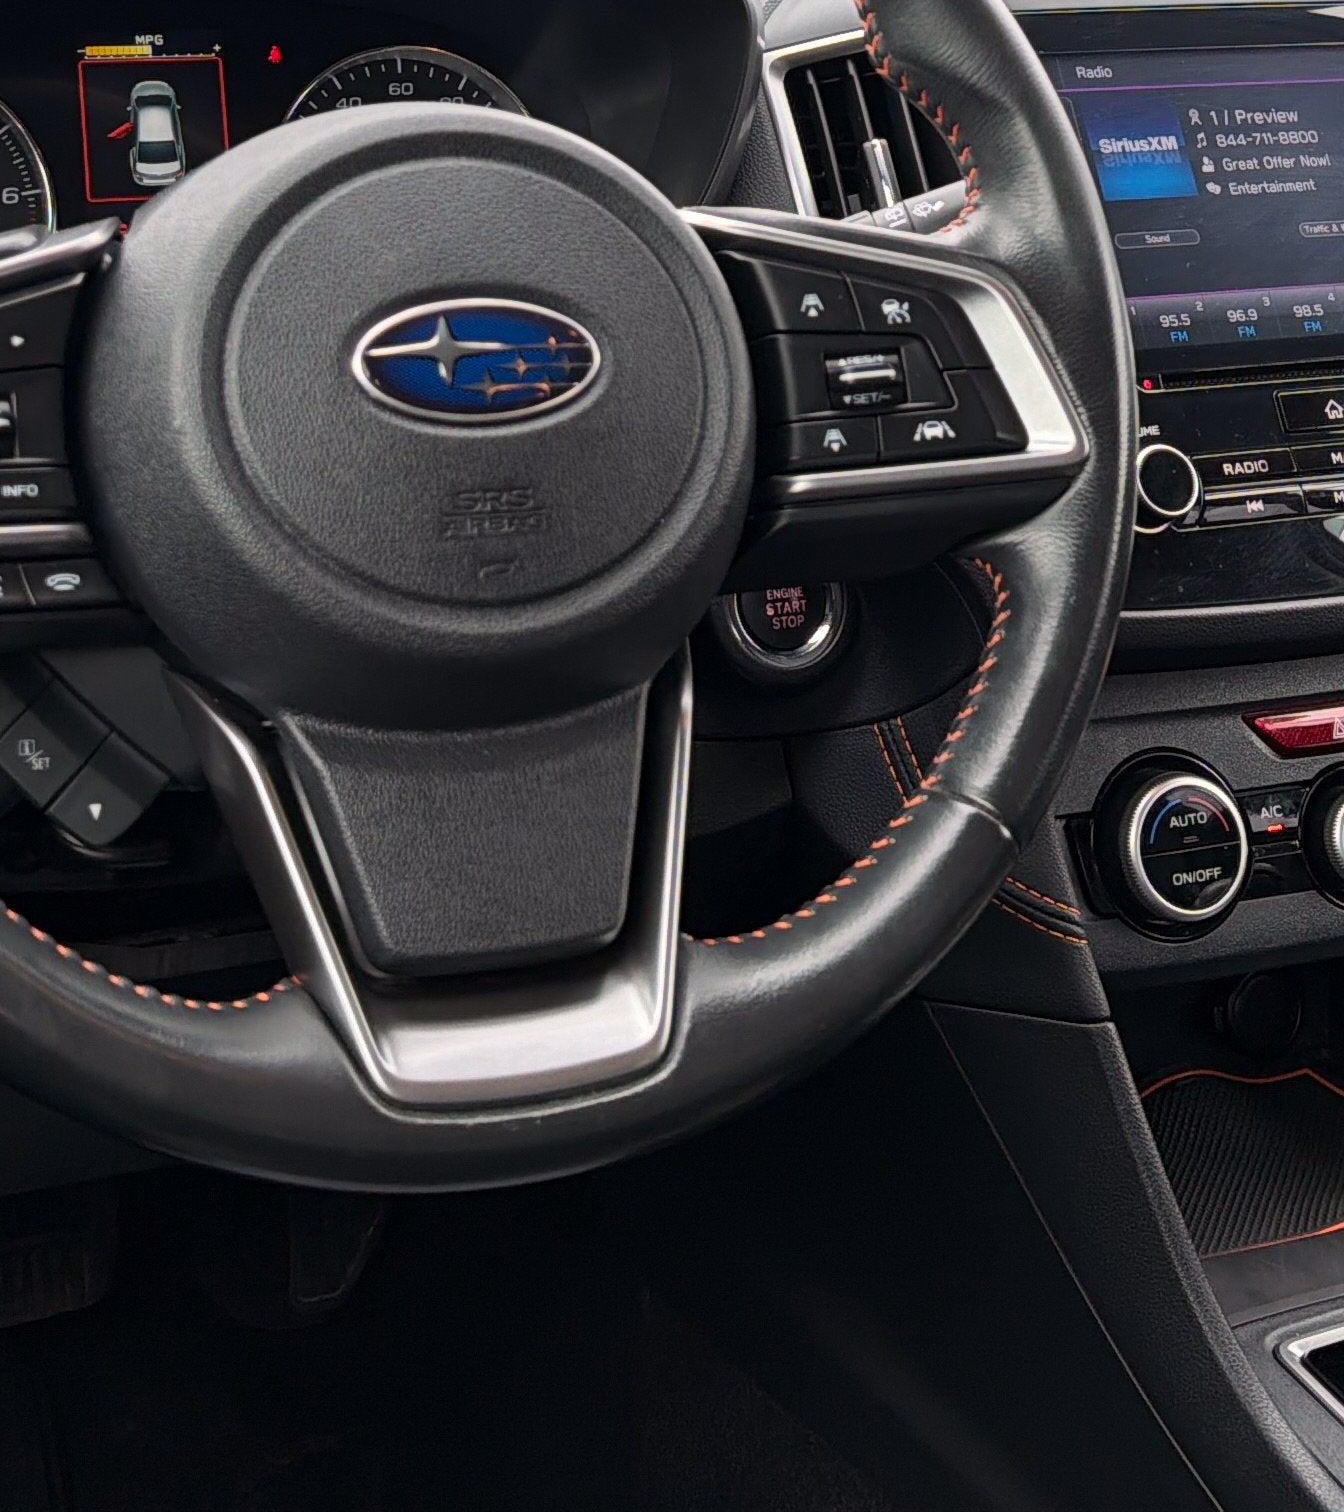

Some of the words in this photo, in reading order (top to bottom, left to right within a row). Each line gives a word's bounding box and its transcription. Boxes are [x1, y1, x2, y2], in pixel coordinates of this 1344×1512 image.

[135, 34, 164, 46] MPG
[1076, 65, 1113, 80] Radio
[388, 82, 414, 96] 60
[1209, 109, 1217, 125] 1
[1235, 107, 1299, 125] Preview
[1098, 135, 1179, 155] SiriusXM
[1215, 130, 1319, 148] 844-711-8800
[1222, 157, 1260, 172] Great
[1262, 155, 1296, 171] Offer
[1300, 153, 1332, 169] Now!
[1228, 178, 1317, 196] Entertainment
[1, 187, 20, 205] 6
[1303, 225, 1330, 234] Traffic
[1332, 224, 1340, 232] &
[1144, 233, 1171, 244] Sound
[1262, 296, 1271, 307] 3
[1327, 292, 1336, 303] 4
[1196, 301, 1204, 312] 2
[1293, 303, 1324, 318] 98.5
[1159, 314, 1191, 328] 95.5
[1226, 308, 1258, 323] 96.9
[1238, 326, 1256, 338] FM
[1303, 320, 1322, 333] FM
[1170, 331, 1189, 343] FM
[1222, 459, 1269, 477] RADIO
[1, 483, 39, 498] INFO
[766, 586, 804, 600] ENGINE
[766, 599, 807, 616] START
[772, 614, 805, 630] STOP
[1260, 804, 1284, 820] A/C
[1169, 810, 1208, 830] AUTO
[1172, 865, 1223, 886] ON/OFF
